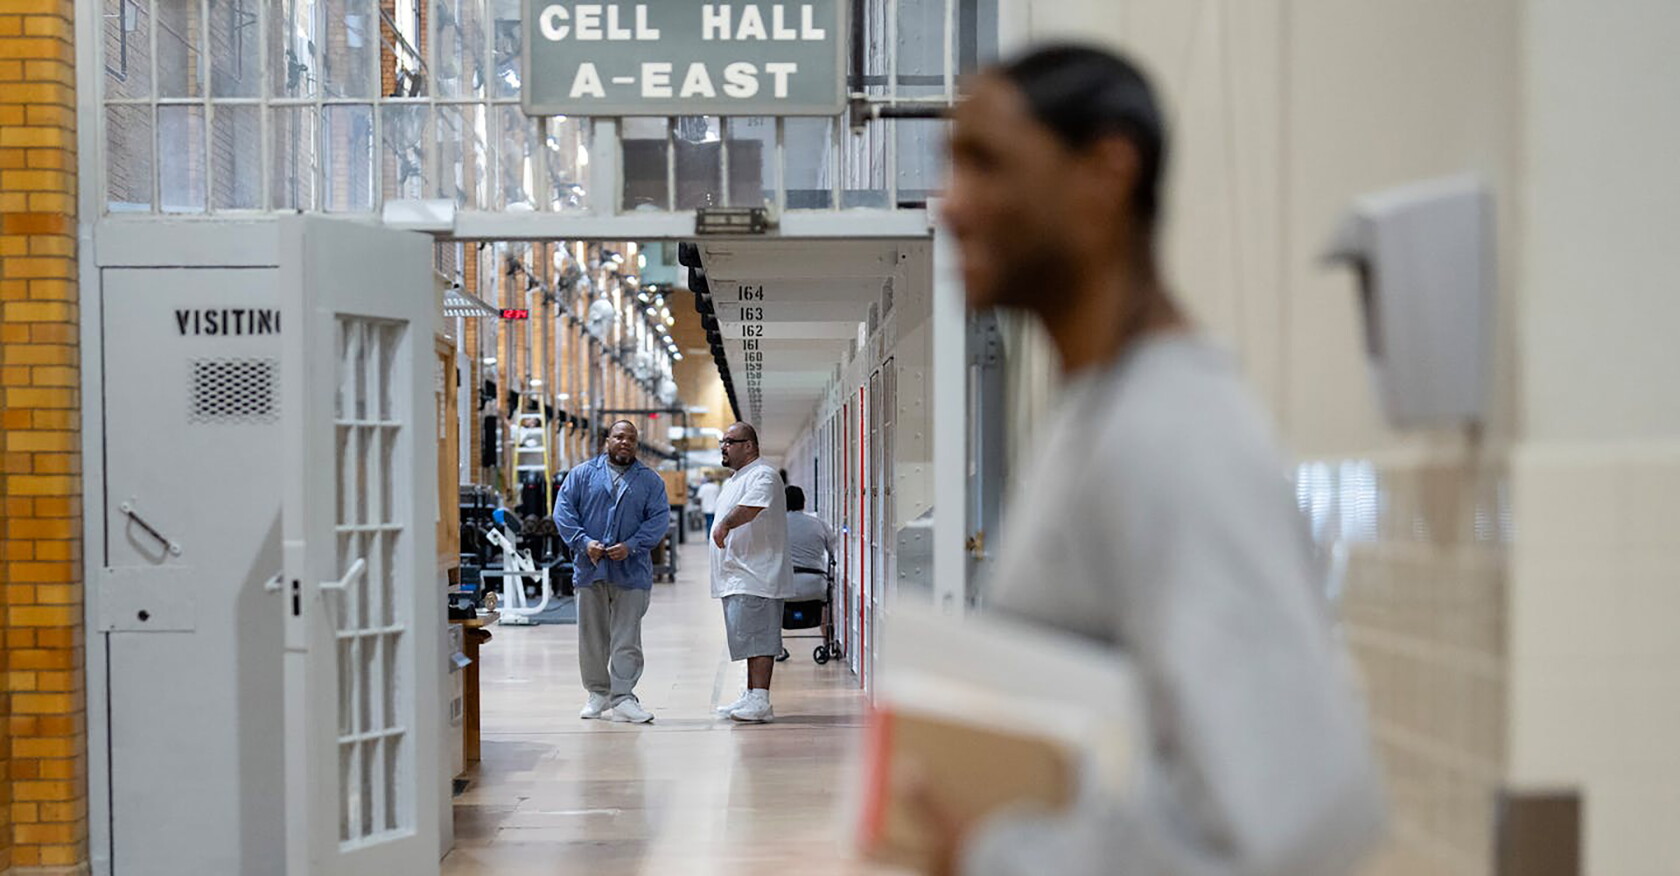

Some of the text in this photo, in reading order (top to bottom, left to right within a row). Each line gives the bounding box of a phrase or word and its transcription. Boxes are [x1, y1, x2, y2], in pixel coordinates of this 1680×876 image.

[539, 4, 826, 41] CELL HALL
[569, 62, 798, 98] A-EAST
[738, 285, 764, 301] 164
[740, 307, 763, 321] 163
[742, 324, 763, 337] 162
[743, 339, 758, 350] 161
[745, 351, 763, 361] 160
[746, 362, 762, 371] 159
